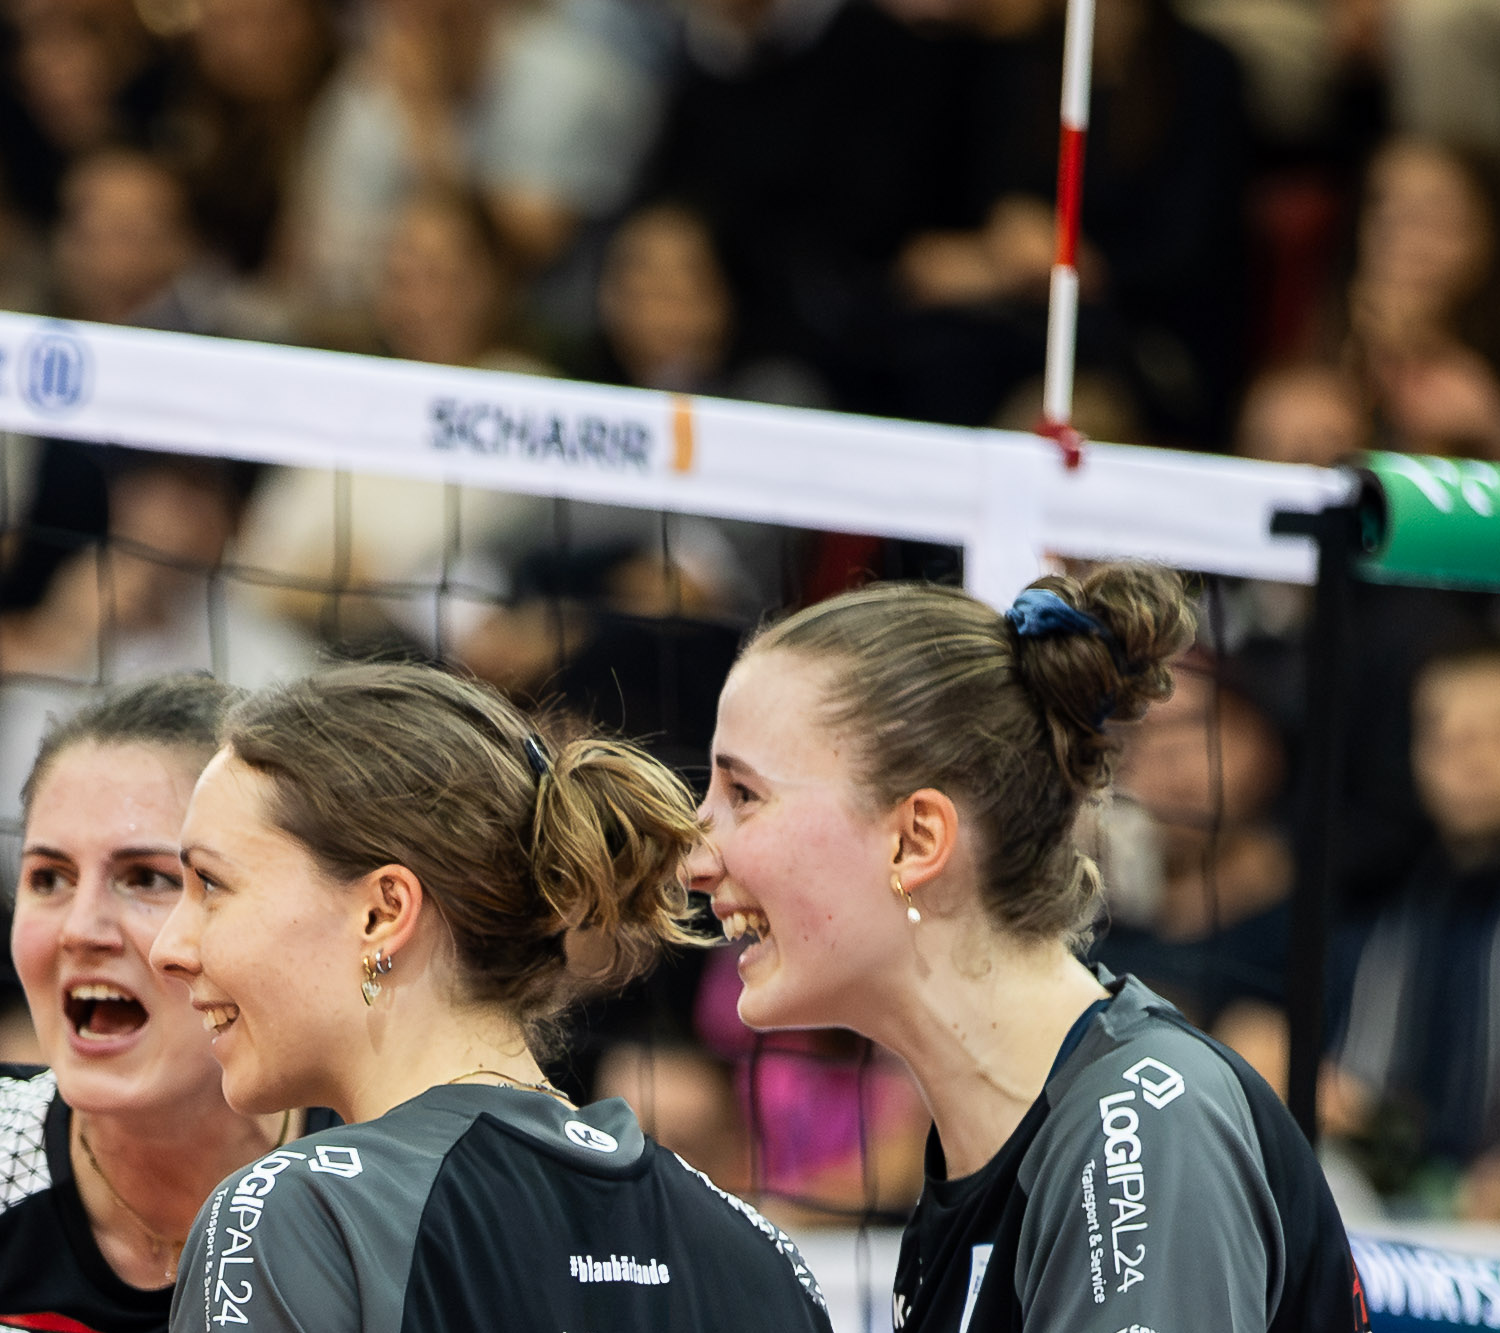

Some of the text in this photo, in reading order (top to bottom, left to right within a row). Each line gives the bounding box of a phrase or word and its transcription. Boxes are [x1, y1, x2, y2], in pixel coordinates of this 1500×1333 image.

[427, 397, 654, 471] SCHARR
[212, 1150, 307, 1327] LOGIPAL24
[1100, 1090, 1150, 1293] LOGIPAL24
